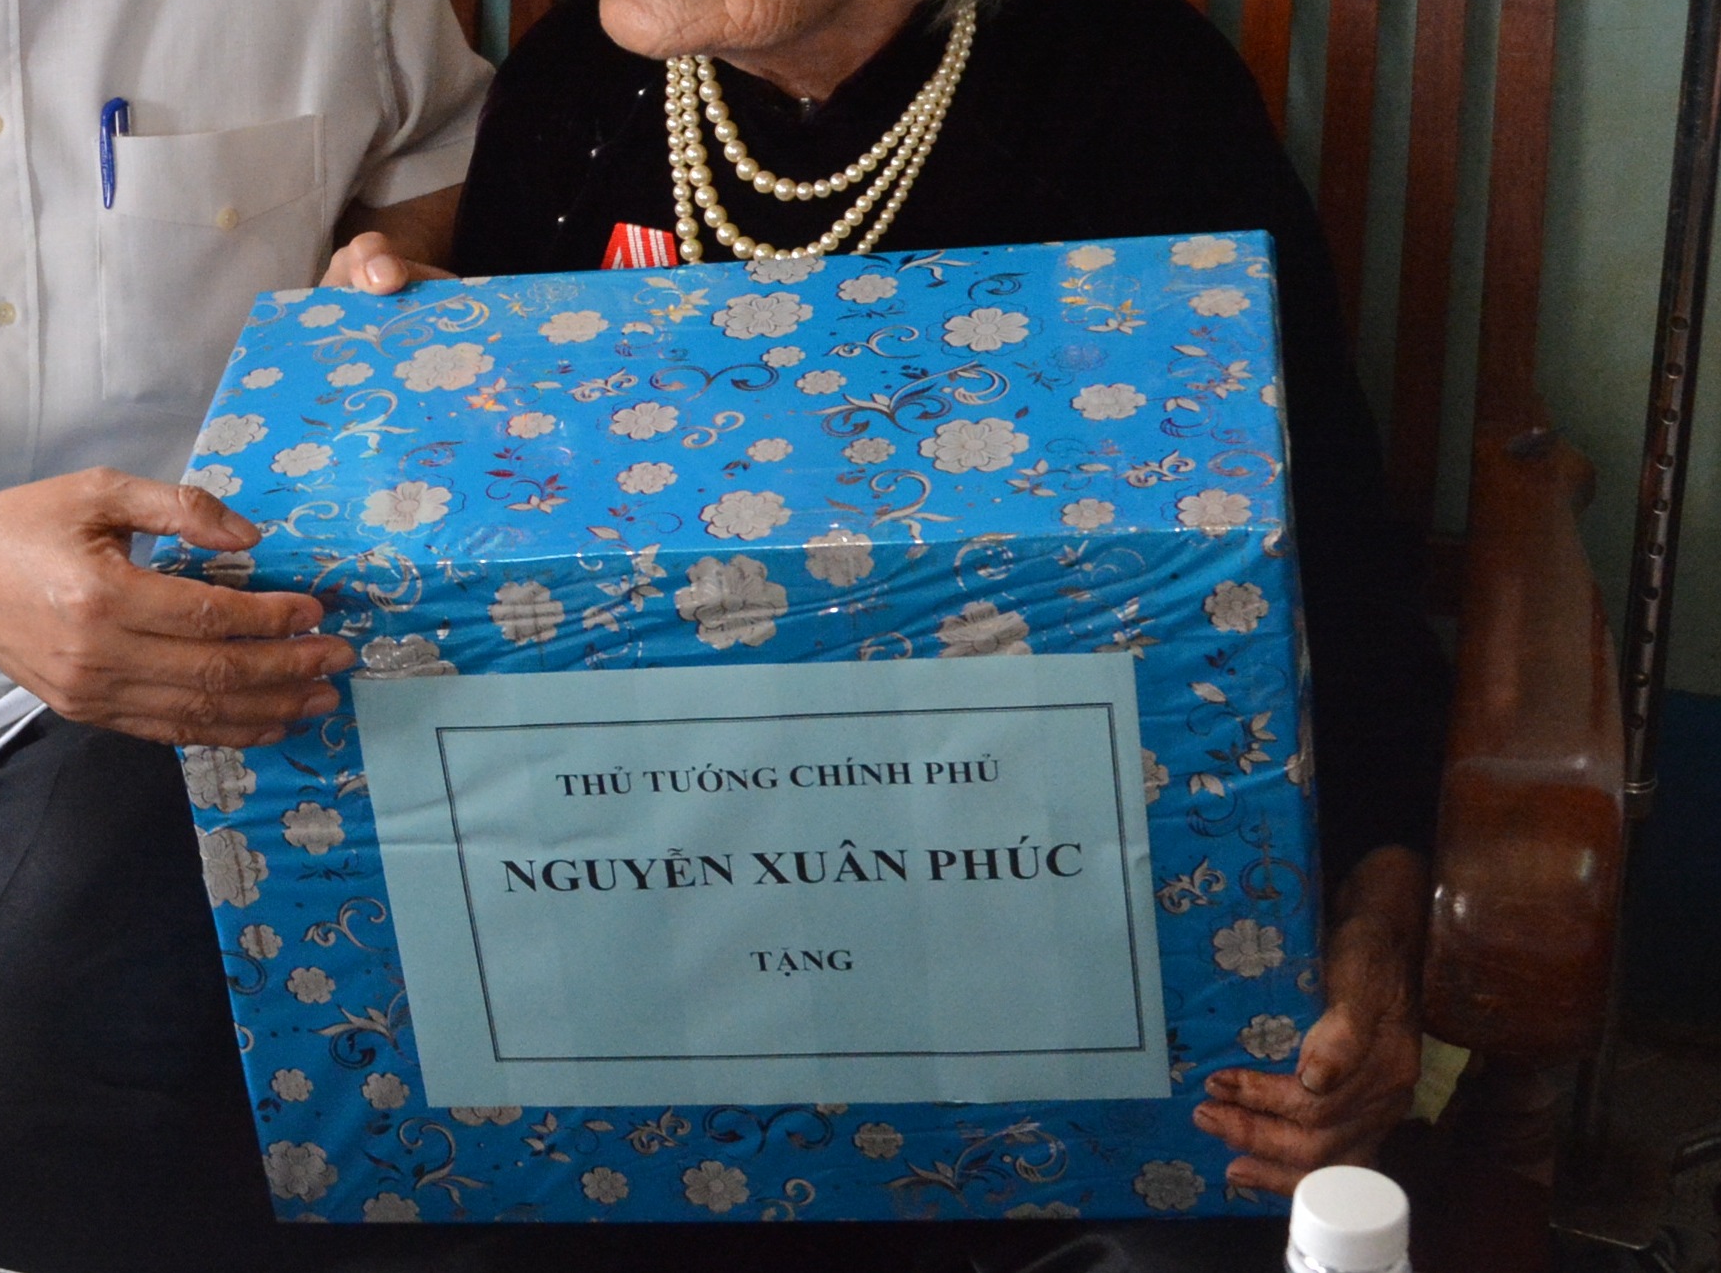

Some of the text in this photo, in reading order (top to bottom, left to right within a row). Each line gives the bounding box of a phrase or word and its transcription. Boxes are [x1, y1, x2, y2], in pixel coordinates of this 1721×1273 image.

[555, 753, 1000, 797] THỦ TƯỚNG CHÍNH PHỦ
[500, 835, 1083, 893] NGUYỄN XUÂN PHÚC
[750, 946, 854, 977] TẶNG
